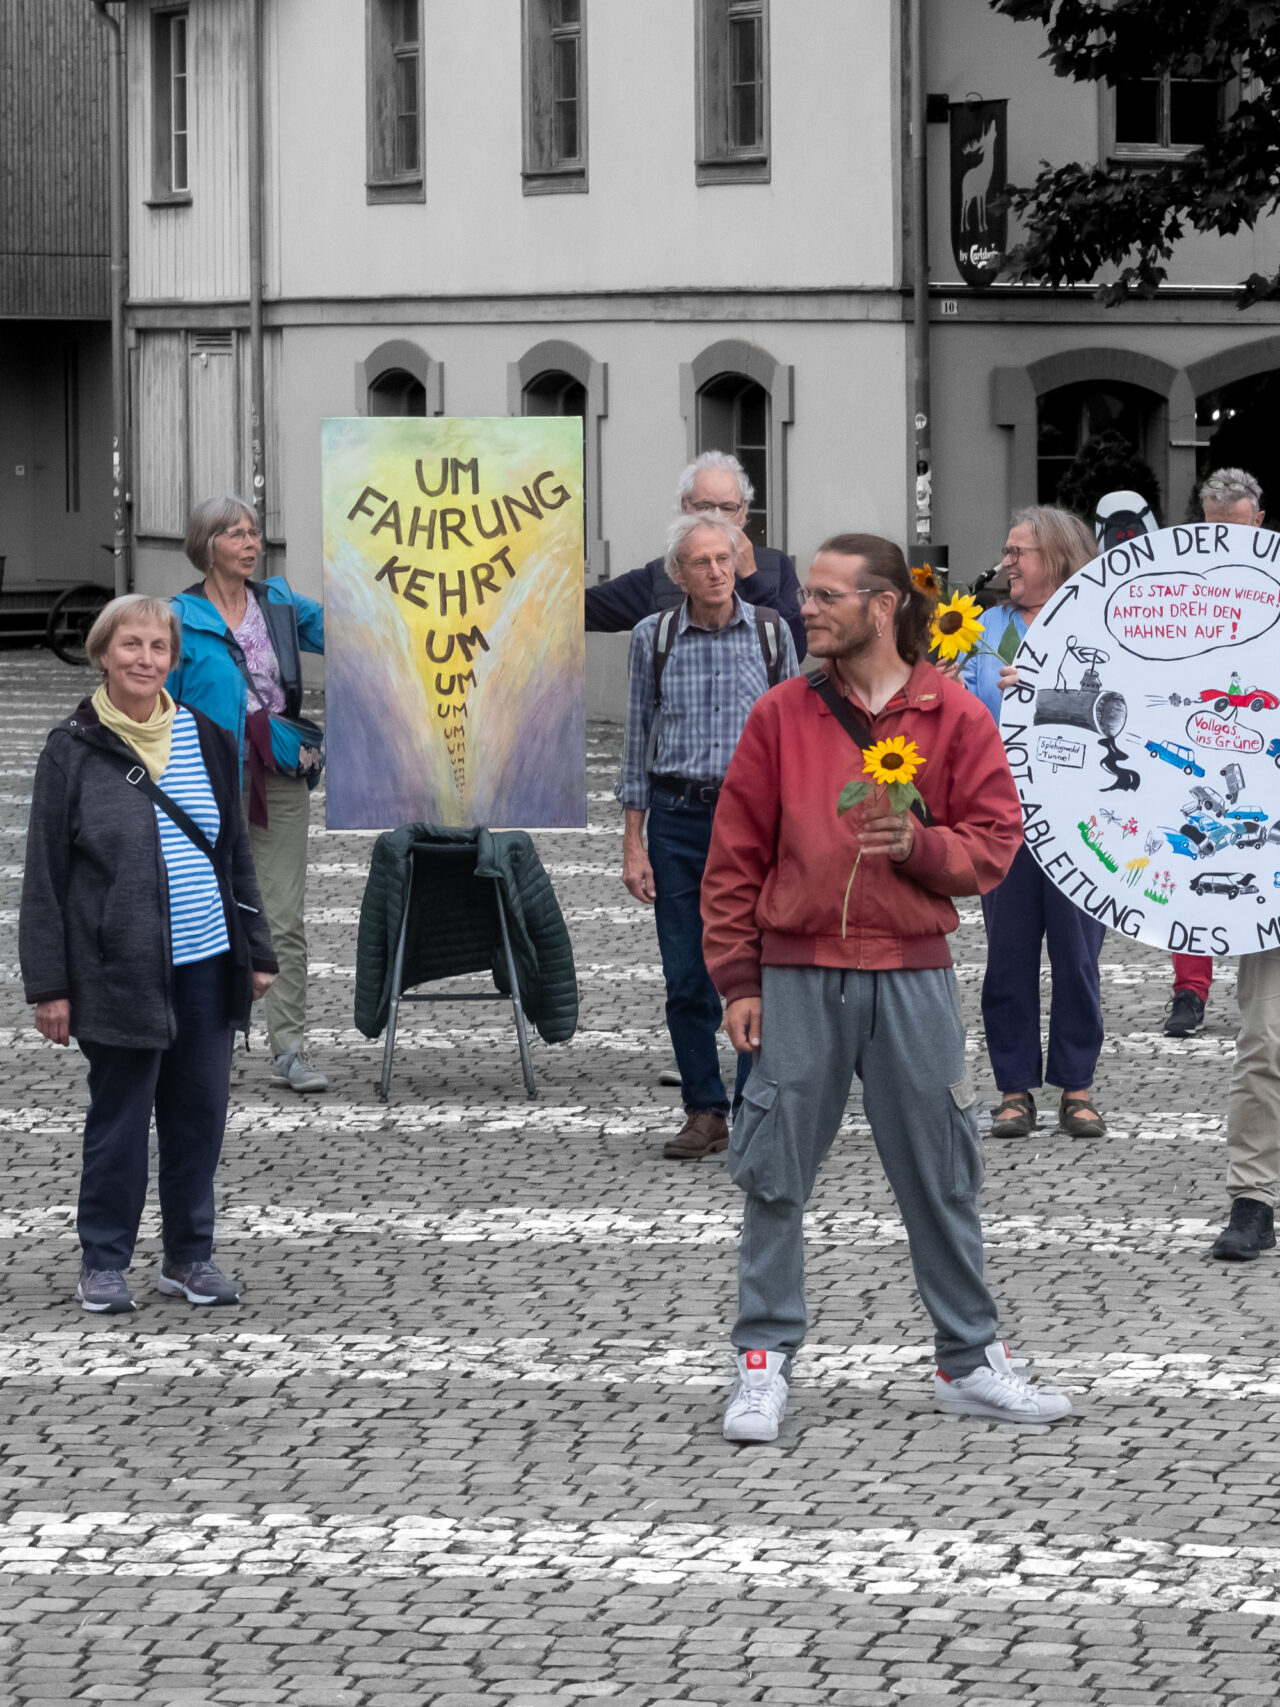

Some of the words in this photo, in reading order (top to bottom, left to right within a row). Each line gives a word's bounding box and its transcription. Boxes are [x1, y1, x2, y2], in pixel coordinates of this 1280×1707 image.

[960, 249, 968, 265] by
[944, 302, 955, 313] 10
[415, 457, 480, 497] UM
[347, 470, 572, 550] FAHRUNG
[1081, 535, 1155, 587] VON
[1172, 525, 1230, 556] DER
[374, 545, 516, 617] KEHRT
[1129, 585, 1143, 598] ES
[1148, 583, 1189, 598] STAUT
[1192, 584, 1231, 599] SCHON
[1113, 605, 1164, 619] ANTON
[1170, 601, 1208, 618] DREH
[1213, 605, 1242, 620] DEN
[1124, 624, 1187, 639] HAHNEN
[425, 625, 490, 663] UM
[435, 669, 477, 695] UM
[437, 702, 468, 718] UM
[443, 725, 465, 739] UM
[1195, 716, 1237, 736] Vollgas
[447, 742, 465, 755] UM
[1196, 730, 1213, 745] ins
[1215, 735, 1260, 750] Grüne
[1004, 641, 1049, 704] ZUR
[1167, 920, 1230, 956] DES
